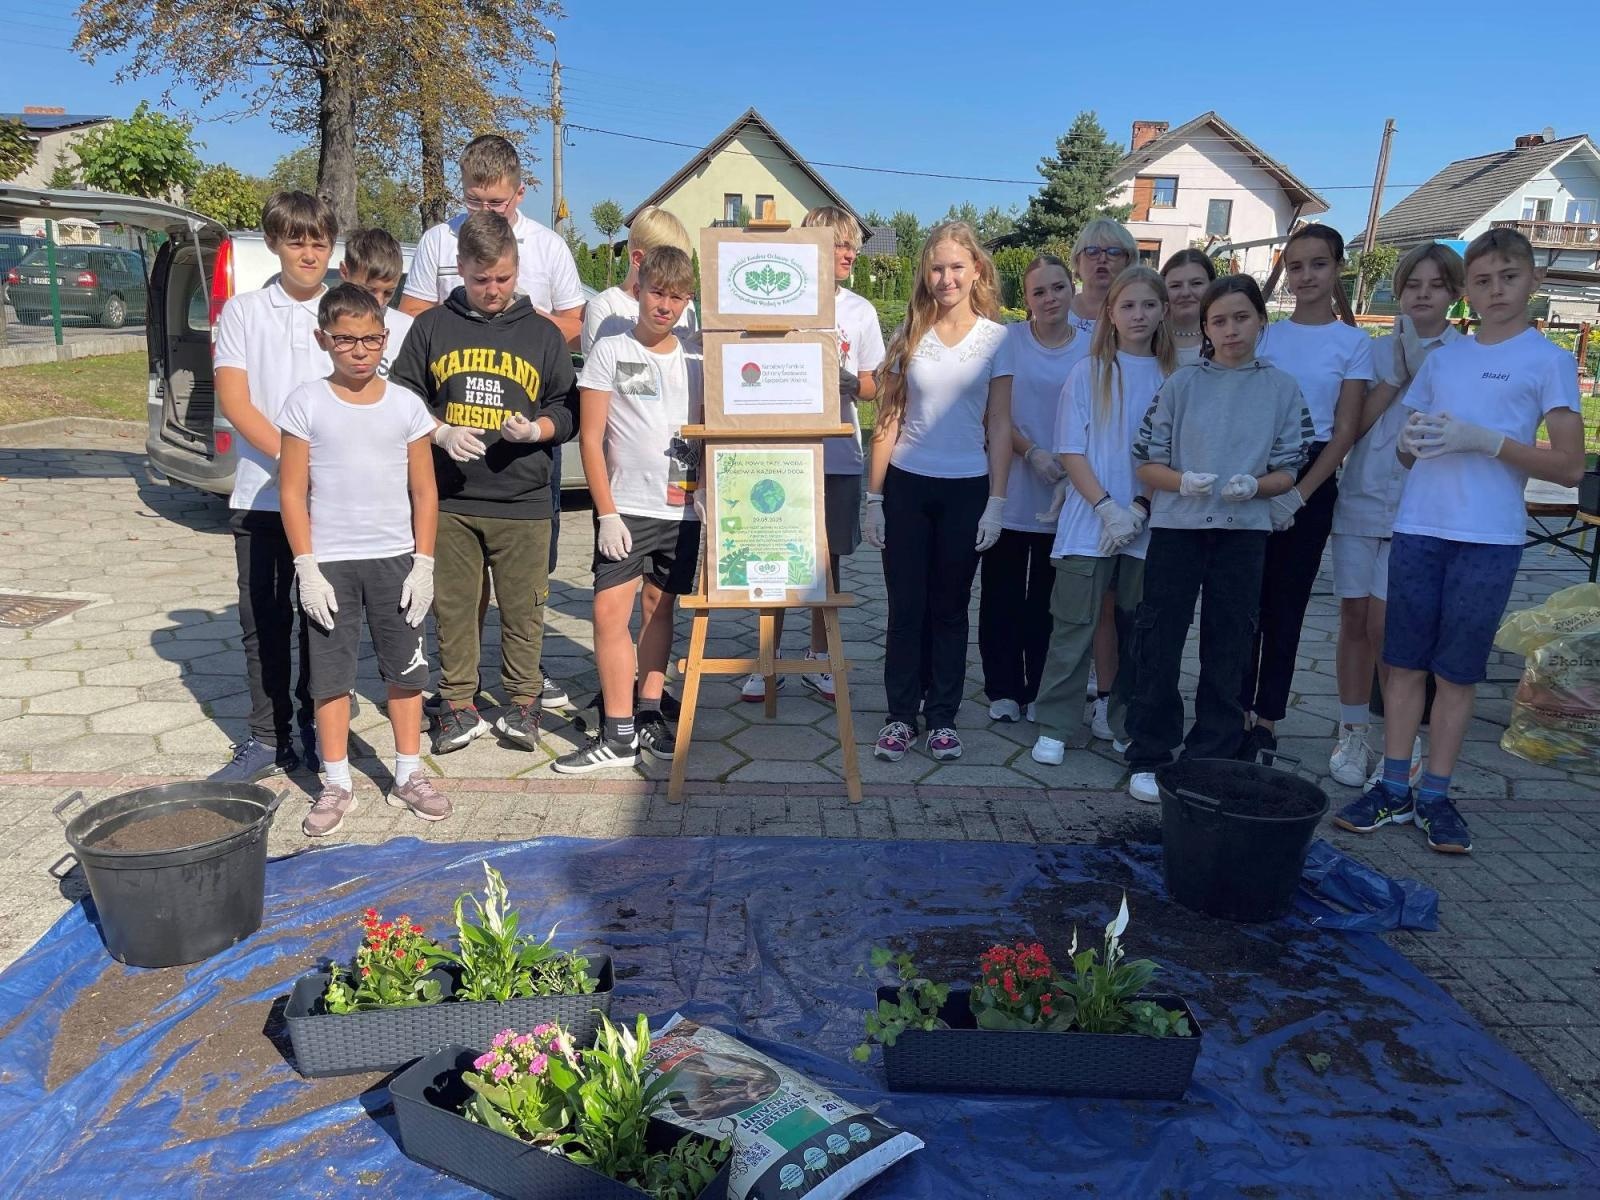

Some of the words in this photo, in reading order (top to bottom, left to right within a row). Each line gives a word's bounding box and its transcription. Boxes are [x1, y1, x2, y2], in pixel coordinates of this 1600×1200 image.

[430, 348, 540, 402] MAIHLAND
[465, 376, 505, 394] MASA.
[465, 390, 504, 407] HERO.
